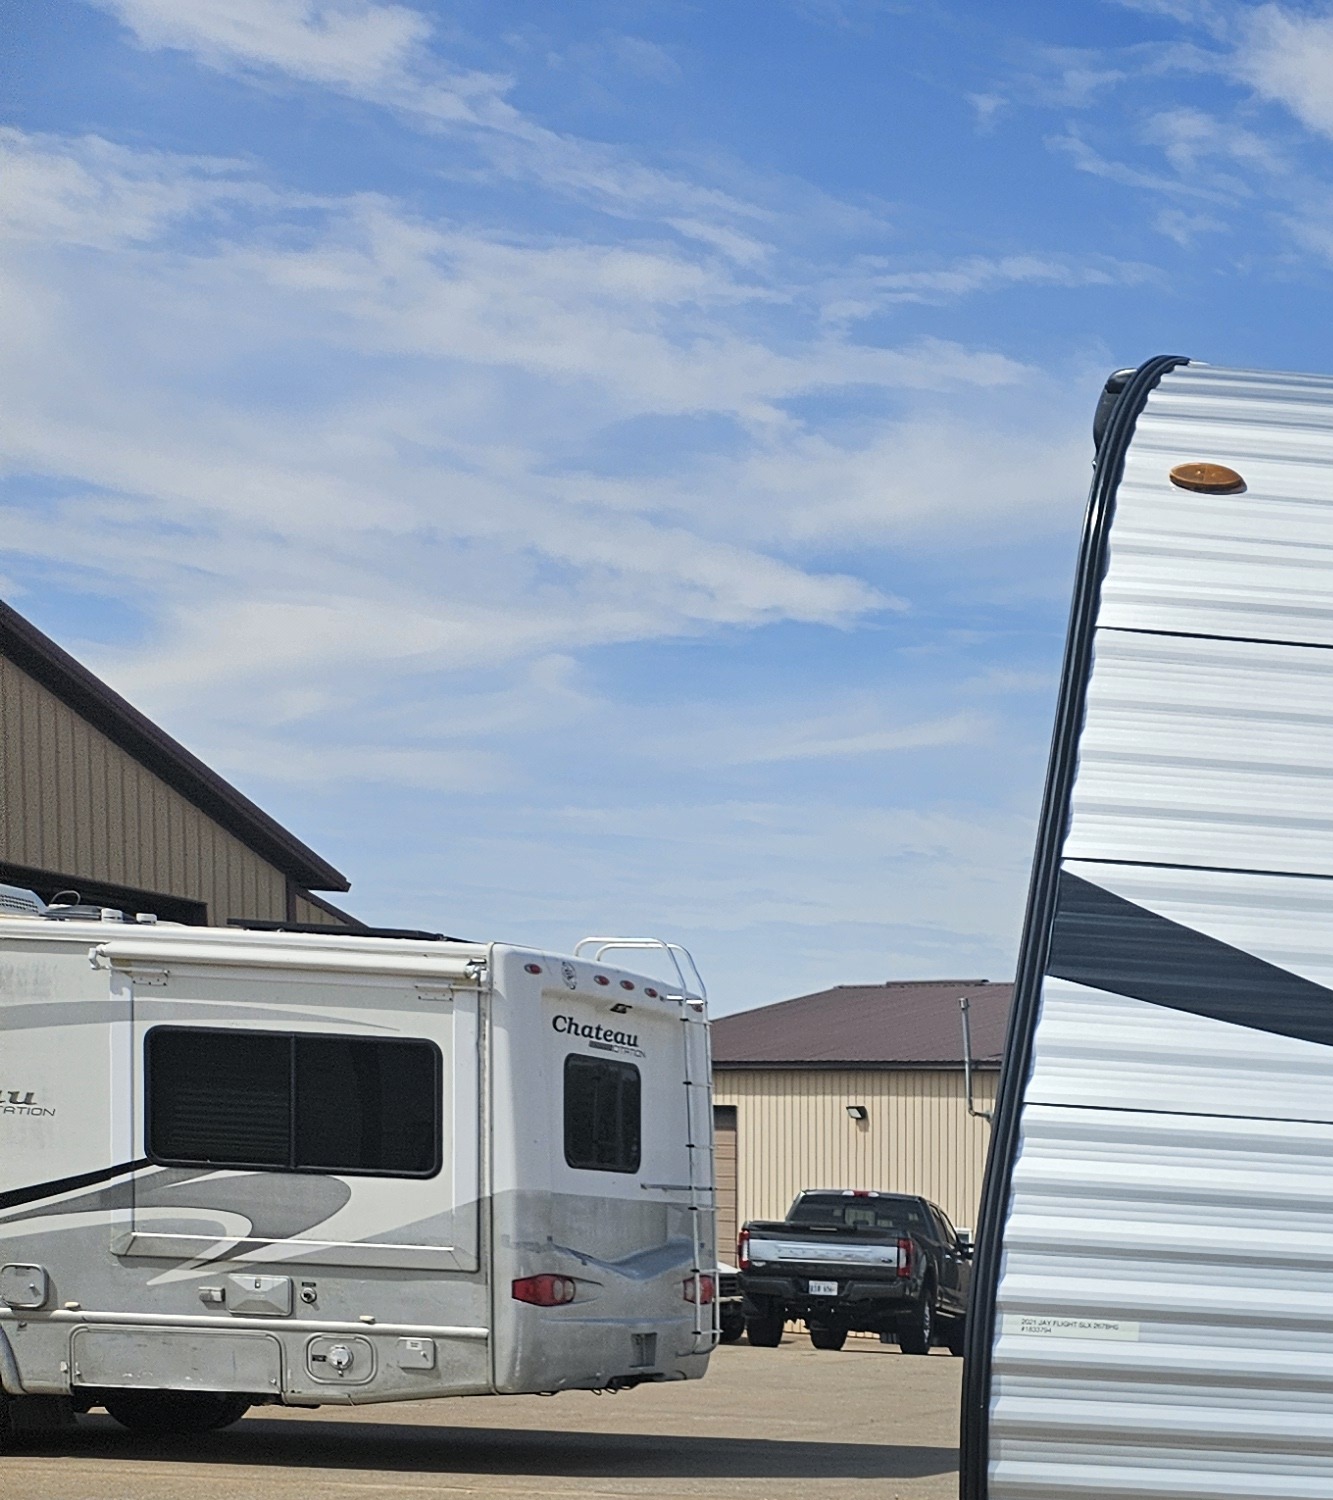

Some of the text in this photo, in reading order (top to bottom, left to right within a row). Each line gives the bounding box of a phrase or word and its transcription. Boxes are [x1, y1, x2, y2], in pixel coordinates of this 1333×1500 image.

[552, 1014, 639, 1047] Chateau
[0, 1090, 37, 1105] u
[1052, 1320, 1077, 1328] FLIGHT
